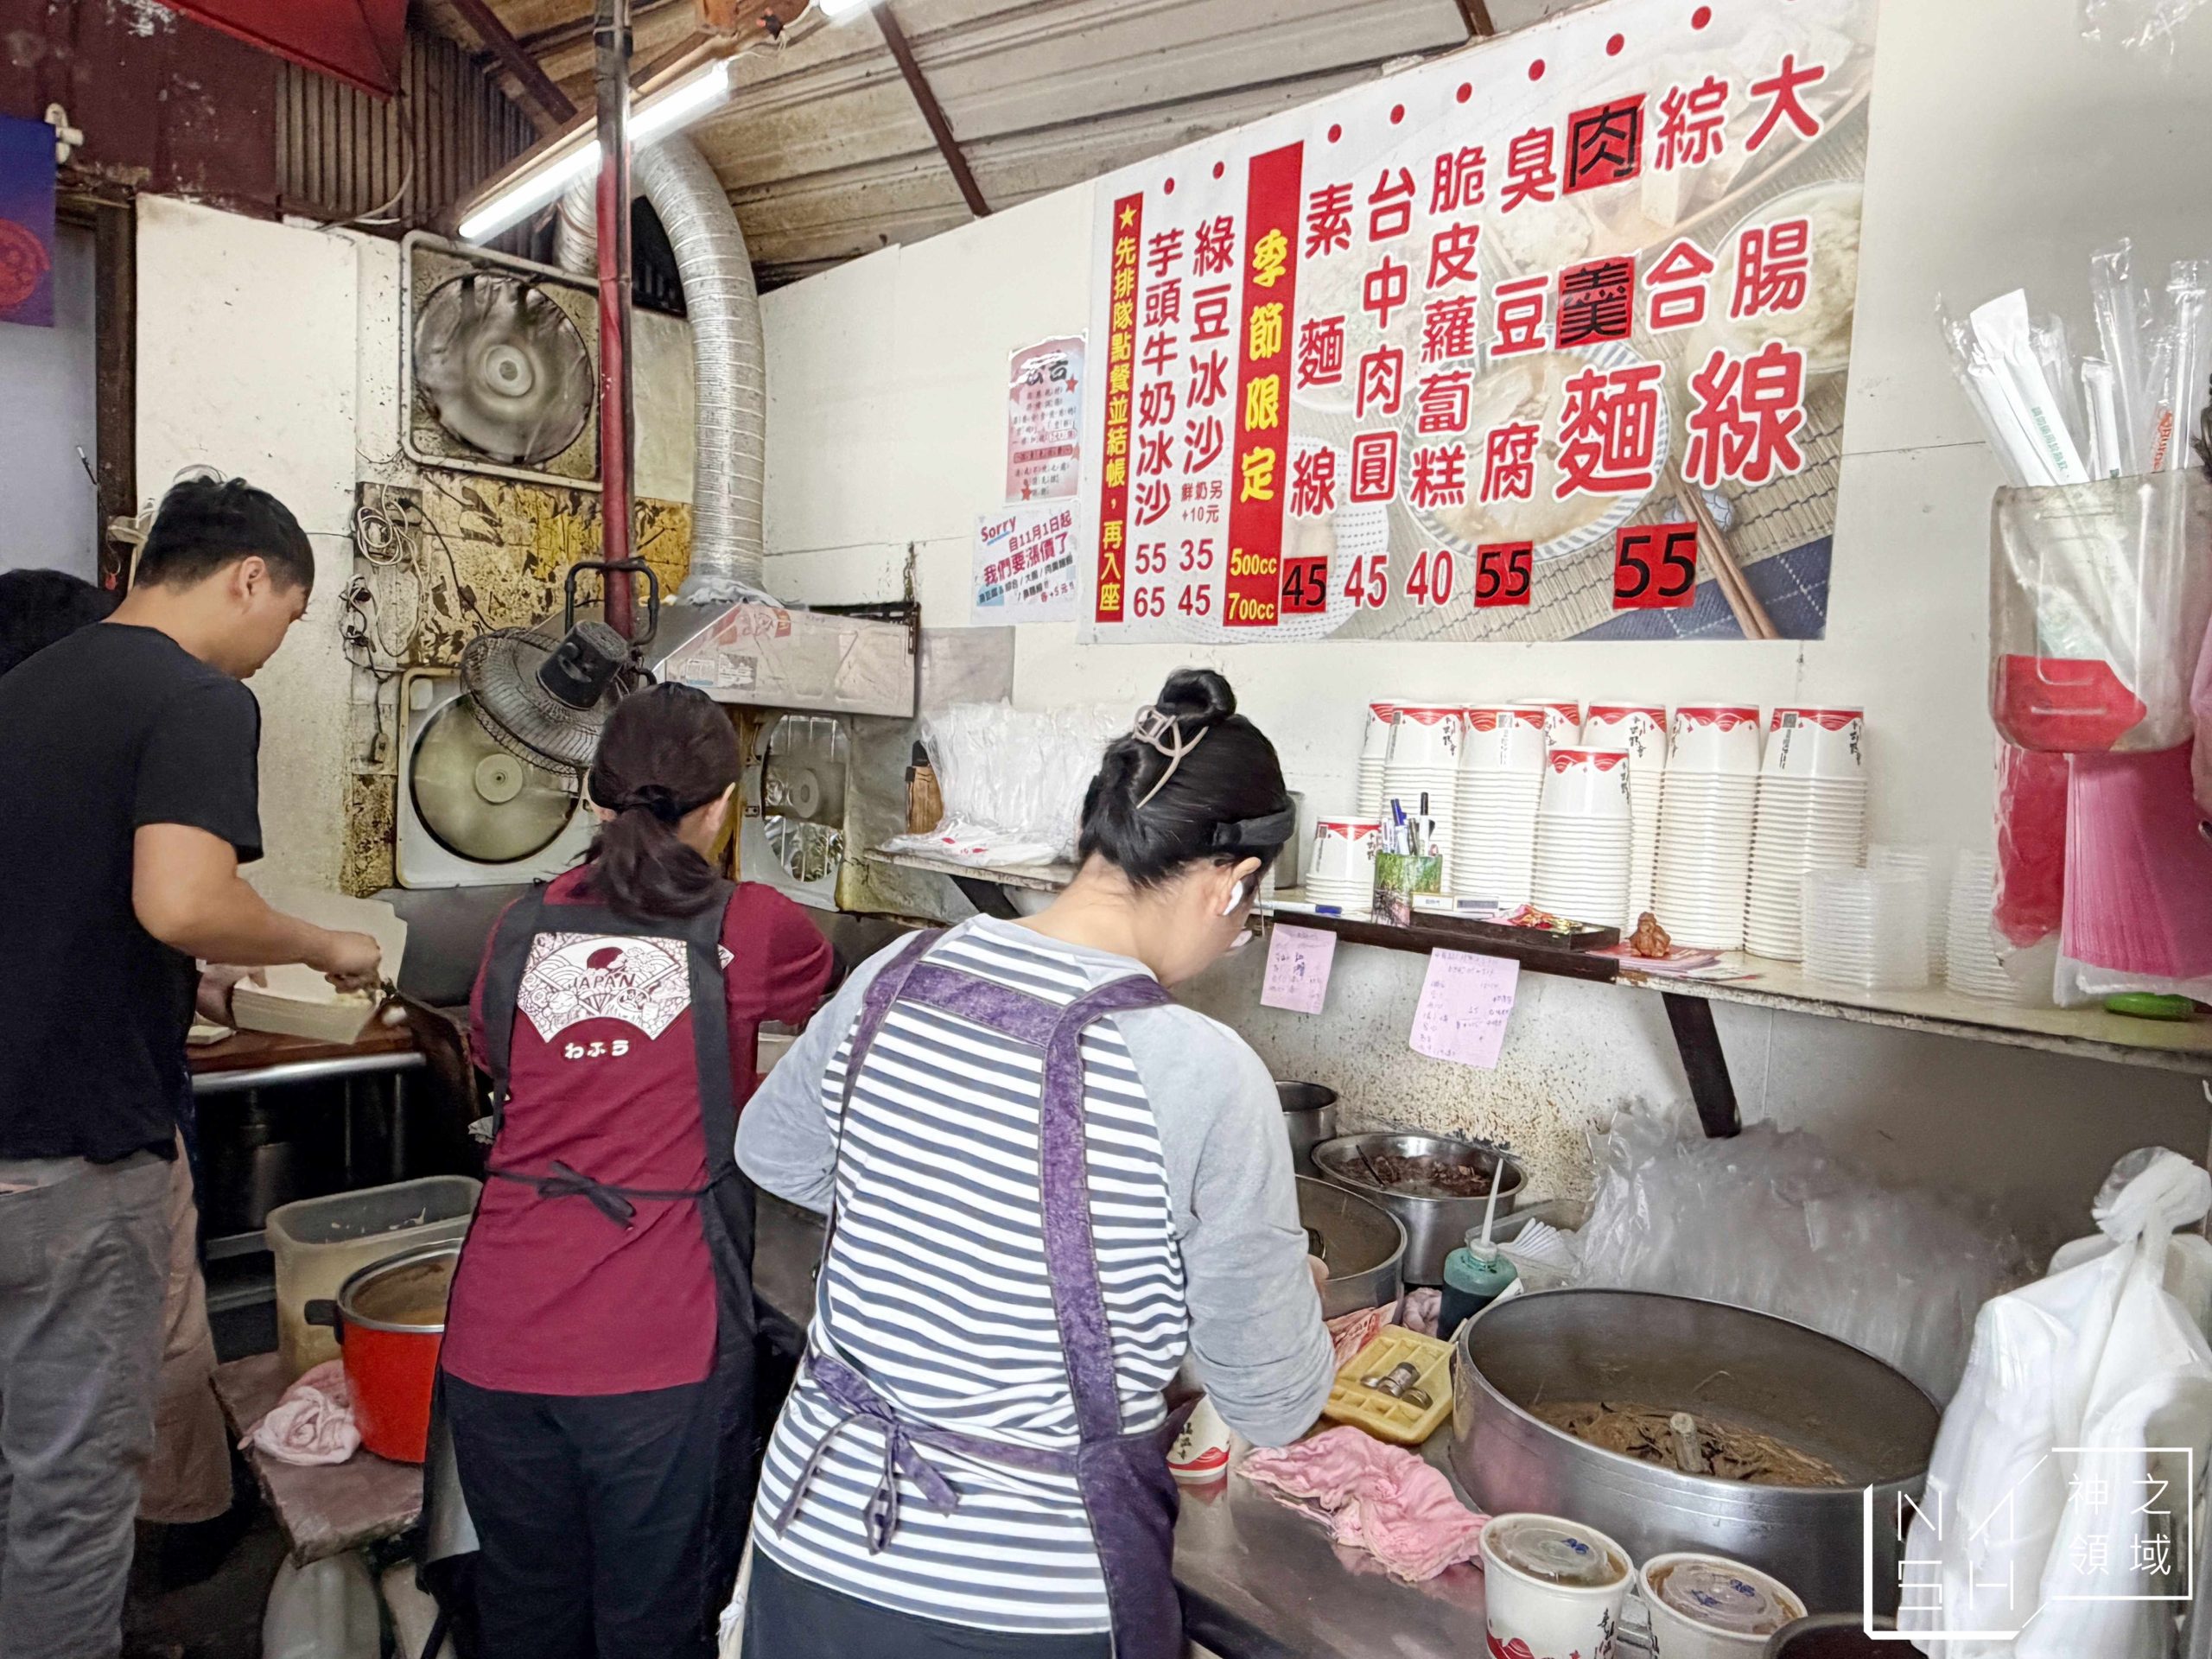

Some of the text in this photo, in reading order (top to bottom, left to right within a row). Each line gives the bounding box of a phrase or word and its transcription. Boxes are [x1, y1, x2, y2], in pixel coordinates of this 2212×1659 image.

[1646, 76, 1728, 330] 綜合
[1351, 168, 1415, 504] 台中肉圓
[1411, 147, 1486, 508] 脆皮蘿蔔糕
[1480, 128, 1557, 503] 臭豆腐
[1183, 215, 1235, 474] 綠豆冰沙
[1239, 228, 1288, 502] 季節限定
[1291, 183, 1353, 516] 素麵線
[1135, 228, 1185, 527] 芋頭牛奶冰沙
[1099, 238, 1136, 612] 先排隊點餐並結帳，再入座
[1181, 480, 1223, 501] 鮮奶另
[1182, 505, 1219, 524] +10元
[981, 516, 1016, 542] Sorry
[1136, 543, 1166, 575] 55
[1179, 538, 1214, 571] 35
[1230, 549, 1277, 576] 500cc
[1407, 550, 1452, 605] 40
[1478, 550, 1530, 598] 55
[1615, 532, 1695, 598] 55
[1133, 586, 1166, 618] 65
[1178, 584, 1211, 616] 45
[1282, 564, 1326, 598] 45
[1344, 555, 1387, 607] 45
[1228, 592, 1274, 620] 700cc
[574, 974, 636, 988] JAPAN
[564, 1039, 630, 1058] わふう
